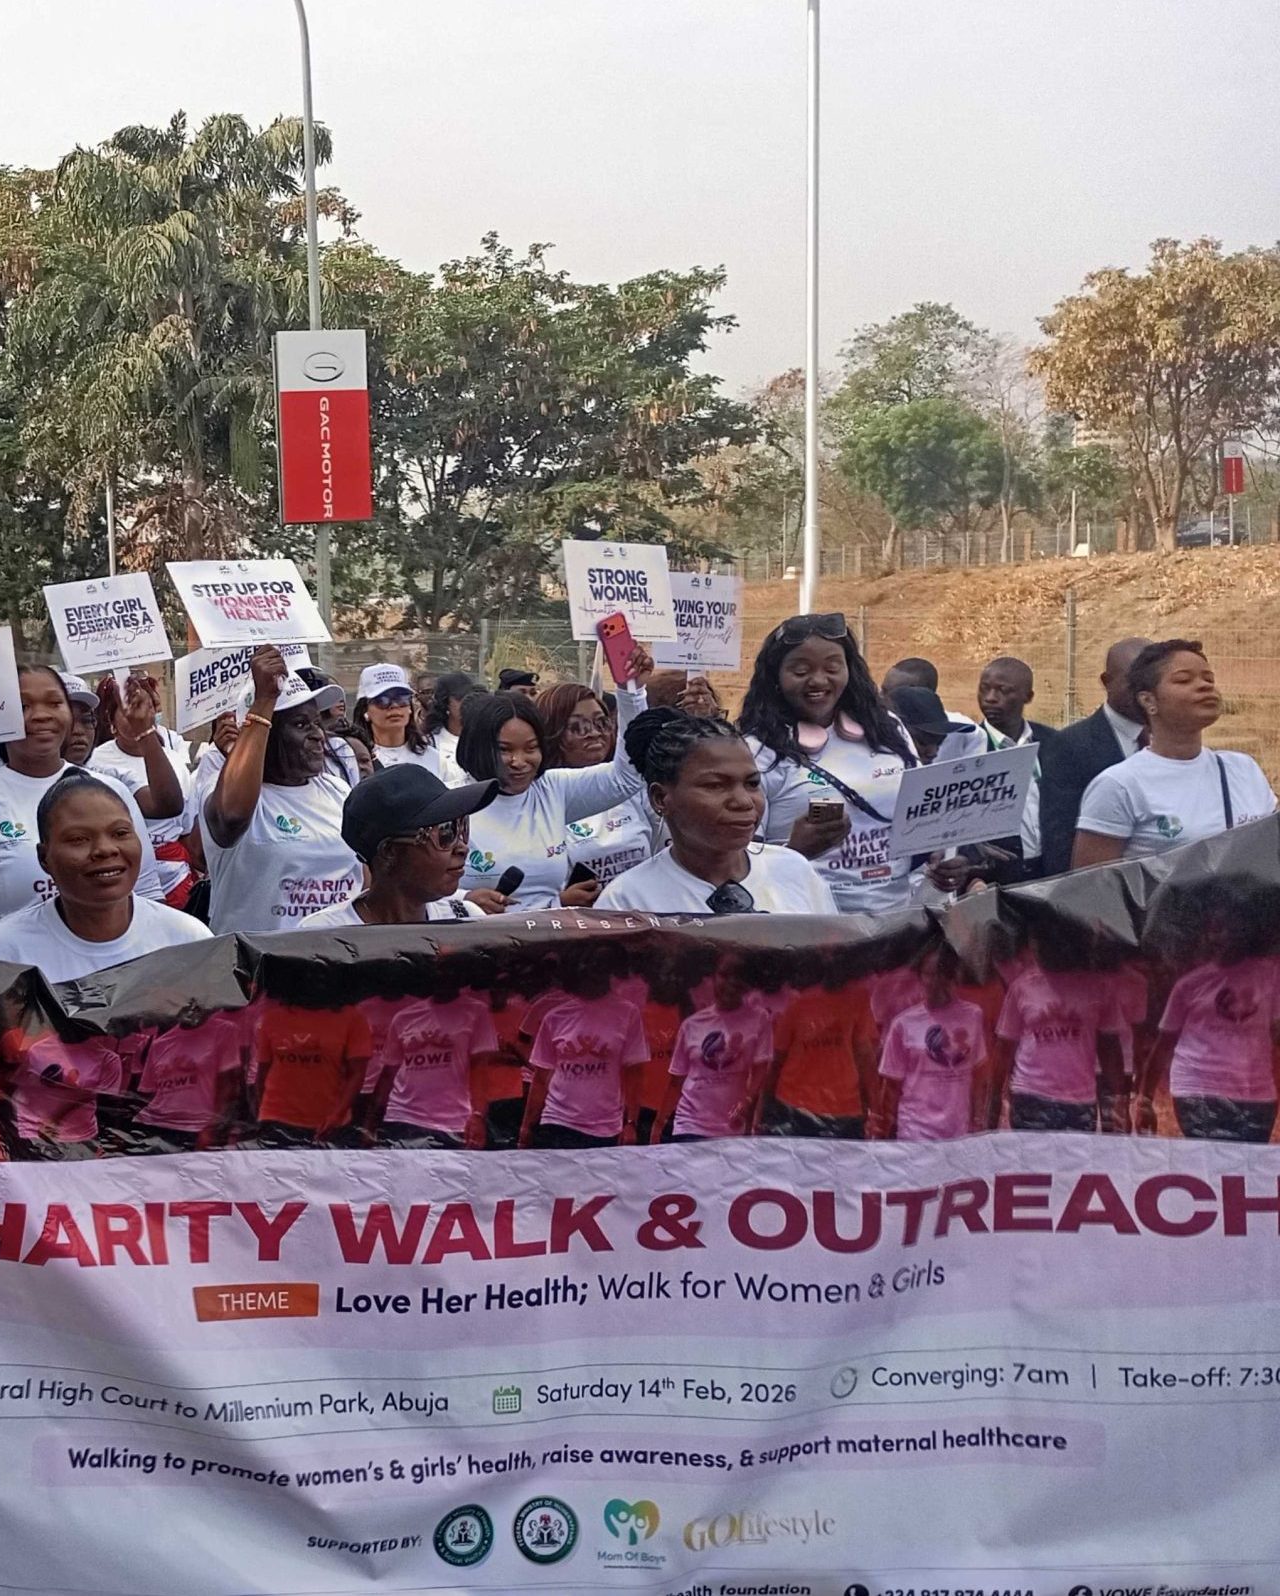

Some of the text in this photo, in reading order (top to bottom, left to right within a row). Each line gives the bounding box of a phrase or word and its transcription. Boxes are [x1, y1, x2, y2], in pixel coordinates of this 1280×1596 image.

[319, 395, 333, 519] GAC MOTOR
[587, 568, 648, 586] STRONG
[191, 581, 296, 598] STEP UP FOR
[589, 584, 653, 604] WOMEN,
[64, 597, 147, 622] EVERY GIRL
[212, 594, 292, 608] WOMEN'S
[672, 599, 705, 614] OVING
[706, 599, 737, 616] YOUR
[66, 611, 154, 637] DESERVES A
[224, 607, 289, 622] HEALTH
[715, 616, 725, 629] IS
[190, 676, 217, 699] HER
[220, 660, 251, 684] BOD
[923, 771, 1011, 802] SUPPORT
[906, 784, 1018, 820] HER HEALTH,
[845, 825, 892, 845] HARIT
[841, 838, 890, 858] WALK
[828, 852, 889, 870] OUTRE
[279, 877, 354, 891] CHARITY
[289, 892, 349, 904] WALK&
[526, 917, 705, 930] PRESENTS
[404, 1052, 453, 1067] VOWE
[329, 1194, 618, 1265] WALK
[636, 1193, 706, 1252] &
[728, 1173, 1280, 1254] OUTREACH
[336, 1259, 945, 1314] Love Her Health; Walk for Women & Girls
[218, 1290, 289, 1312] THEME
[871, 1363, 1069, 1390] Converging: 7am
[1118, 1366, 1231, 1388] Take-off:
[39, 1379, 94, 1407] High
[100, 1386, 168, 1412] Court
[174, 1401, 198, 1419] to
[204, 1397, 313, 1423] Millennium
[319, 1391, 375, 1415] Park,
[382, 1391, 449, 1417] Abuja
[536, 1377, 797, 1405] Saturday 14th Feb, 2026
[69, 1447, 157, 1473] Walking
[163, 1452, 186, 1470] to
[191, 1459, 290, 1487] promote
[295, 1461, 384, 1487] women's
[388, 1459, 406, 1480] &
[467, 1451, 536, 1477] health,
[541, 1444, 594, 1466] raise
[599, 1447, 734, 1471] awareness,
[739, 1449, 754, 1467] &
[758, 1436, 831, 1464] support
[836, 1431, 937, 1454] maternal
[942, 1427, 1068, 1451] healthcare
[307, 1534, 423, 1554] SUPPORTED BY:
[597, 1551, 623, 1561] Mom
[640, 1552, 667, 1565] Boys
[720, 1584, 810, 1596] foundation
